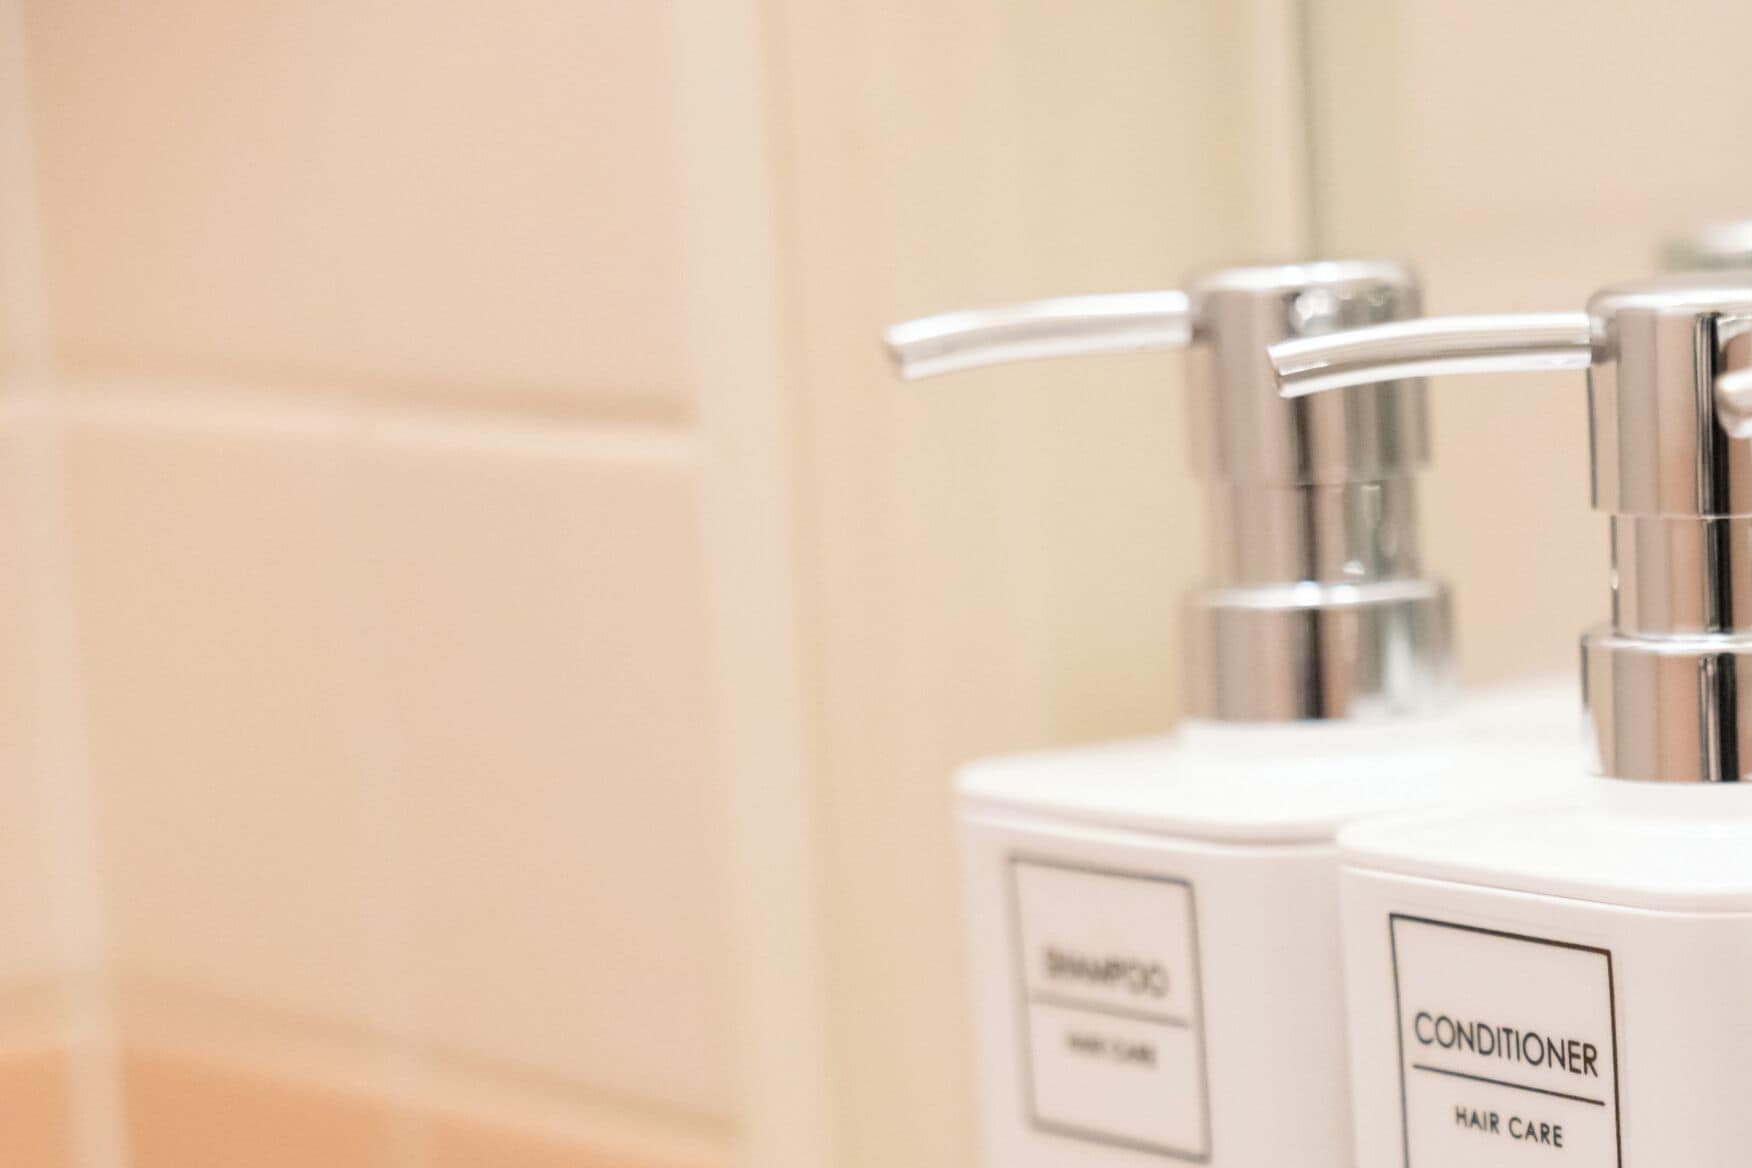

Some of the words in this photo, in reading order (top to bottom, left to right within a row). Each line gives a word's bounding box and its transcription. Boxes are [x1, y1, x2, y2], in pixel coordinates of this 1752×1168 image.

[1414, 1011, 1599, 1078] CONDITIONER
[1455, 1106, 1500, 1134] HAIR
[1508, 1116, 1564, 1148] CARE
